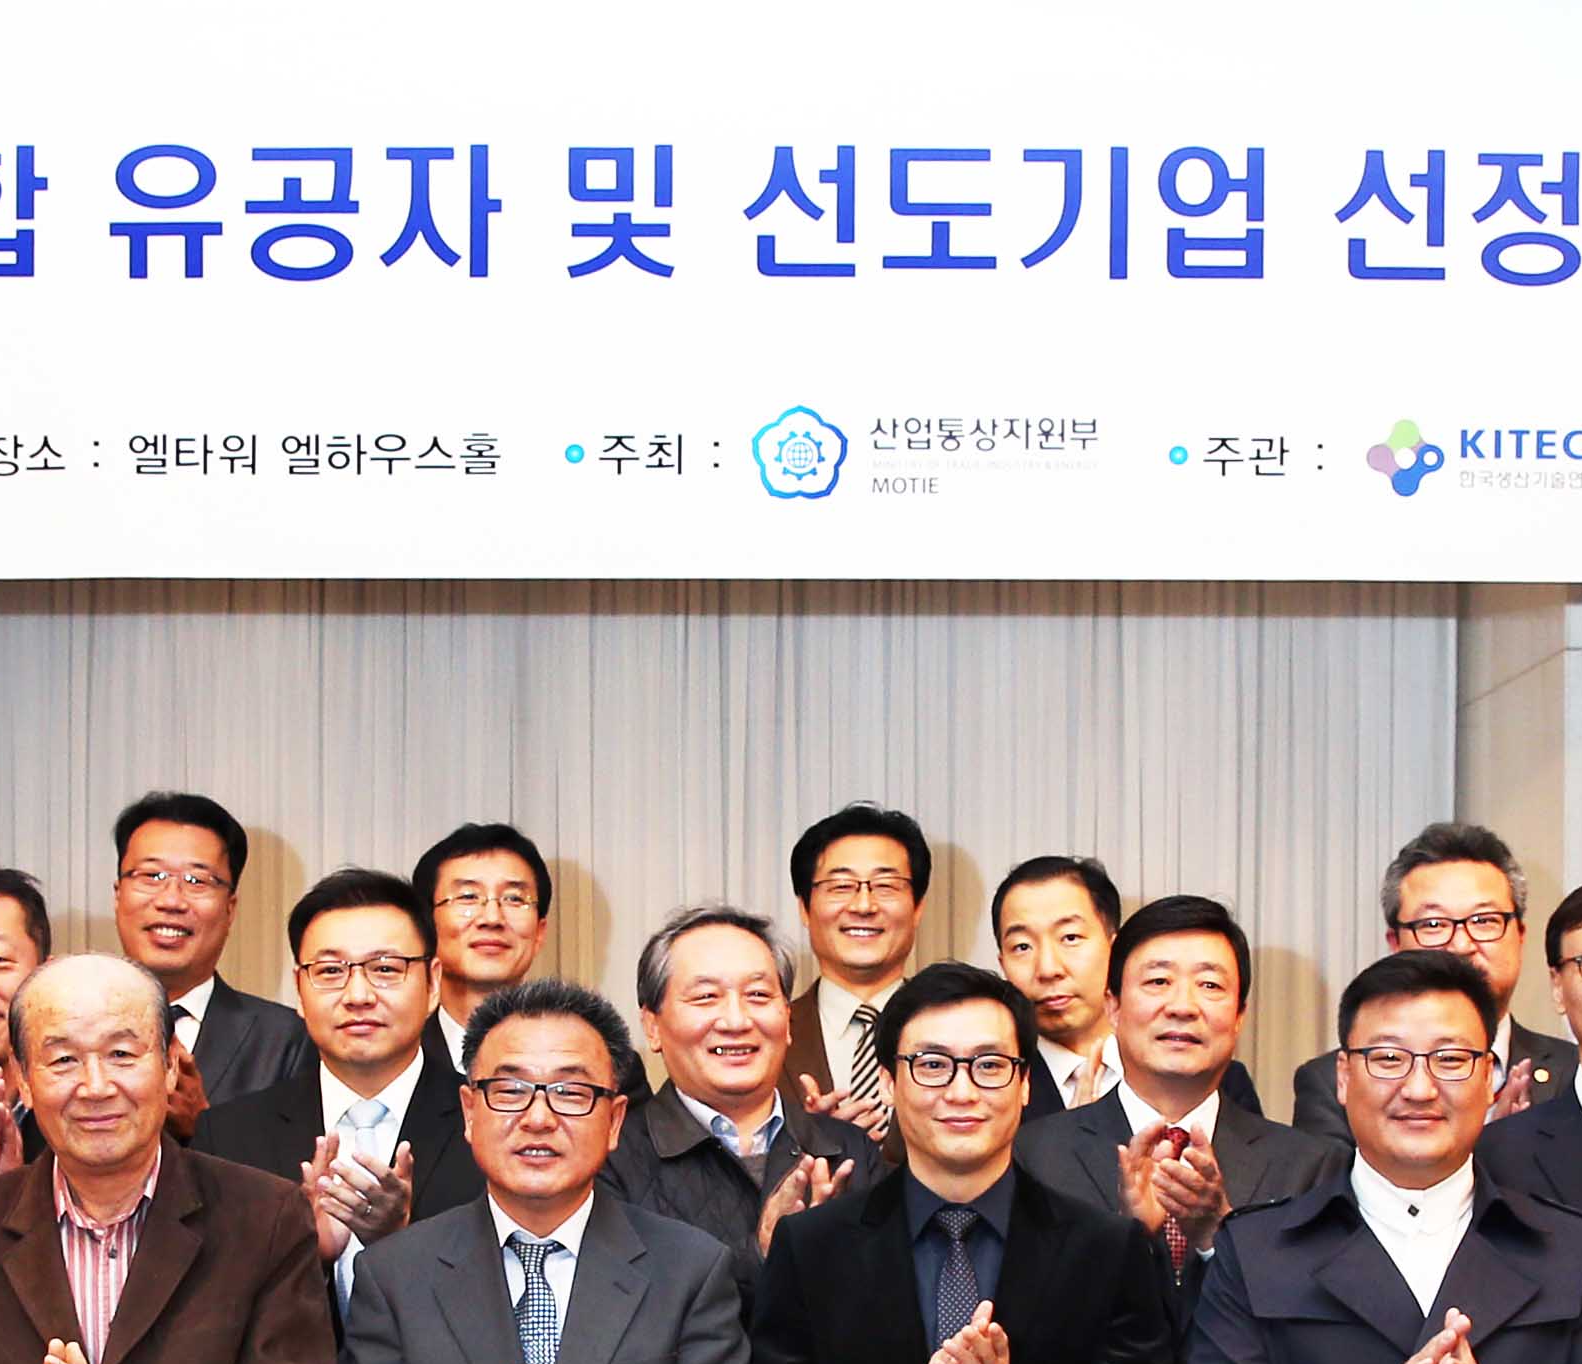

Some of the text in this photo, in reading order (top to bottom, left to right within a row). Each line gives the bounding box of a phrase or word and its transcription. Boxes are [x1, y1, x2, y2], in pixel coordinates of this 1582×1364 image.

[108, 143, 503, 282] 유공자
[566, 144, 676, 279] 및
[742, 144, 1266, 280] 선도기업
[127, 432, 258, 477] 엘타워
[280, 432, 502, 477] 엘하우스홀
[597, 432, 684, 476] 주최
[869, 416, 1099, 452] 산업통상자원부
[1201, 435, 1291, 478] 주관
[871, 476, 939, 495] MOTIE
